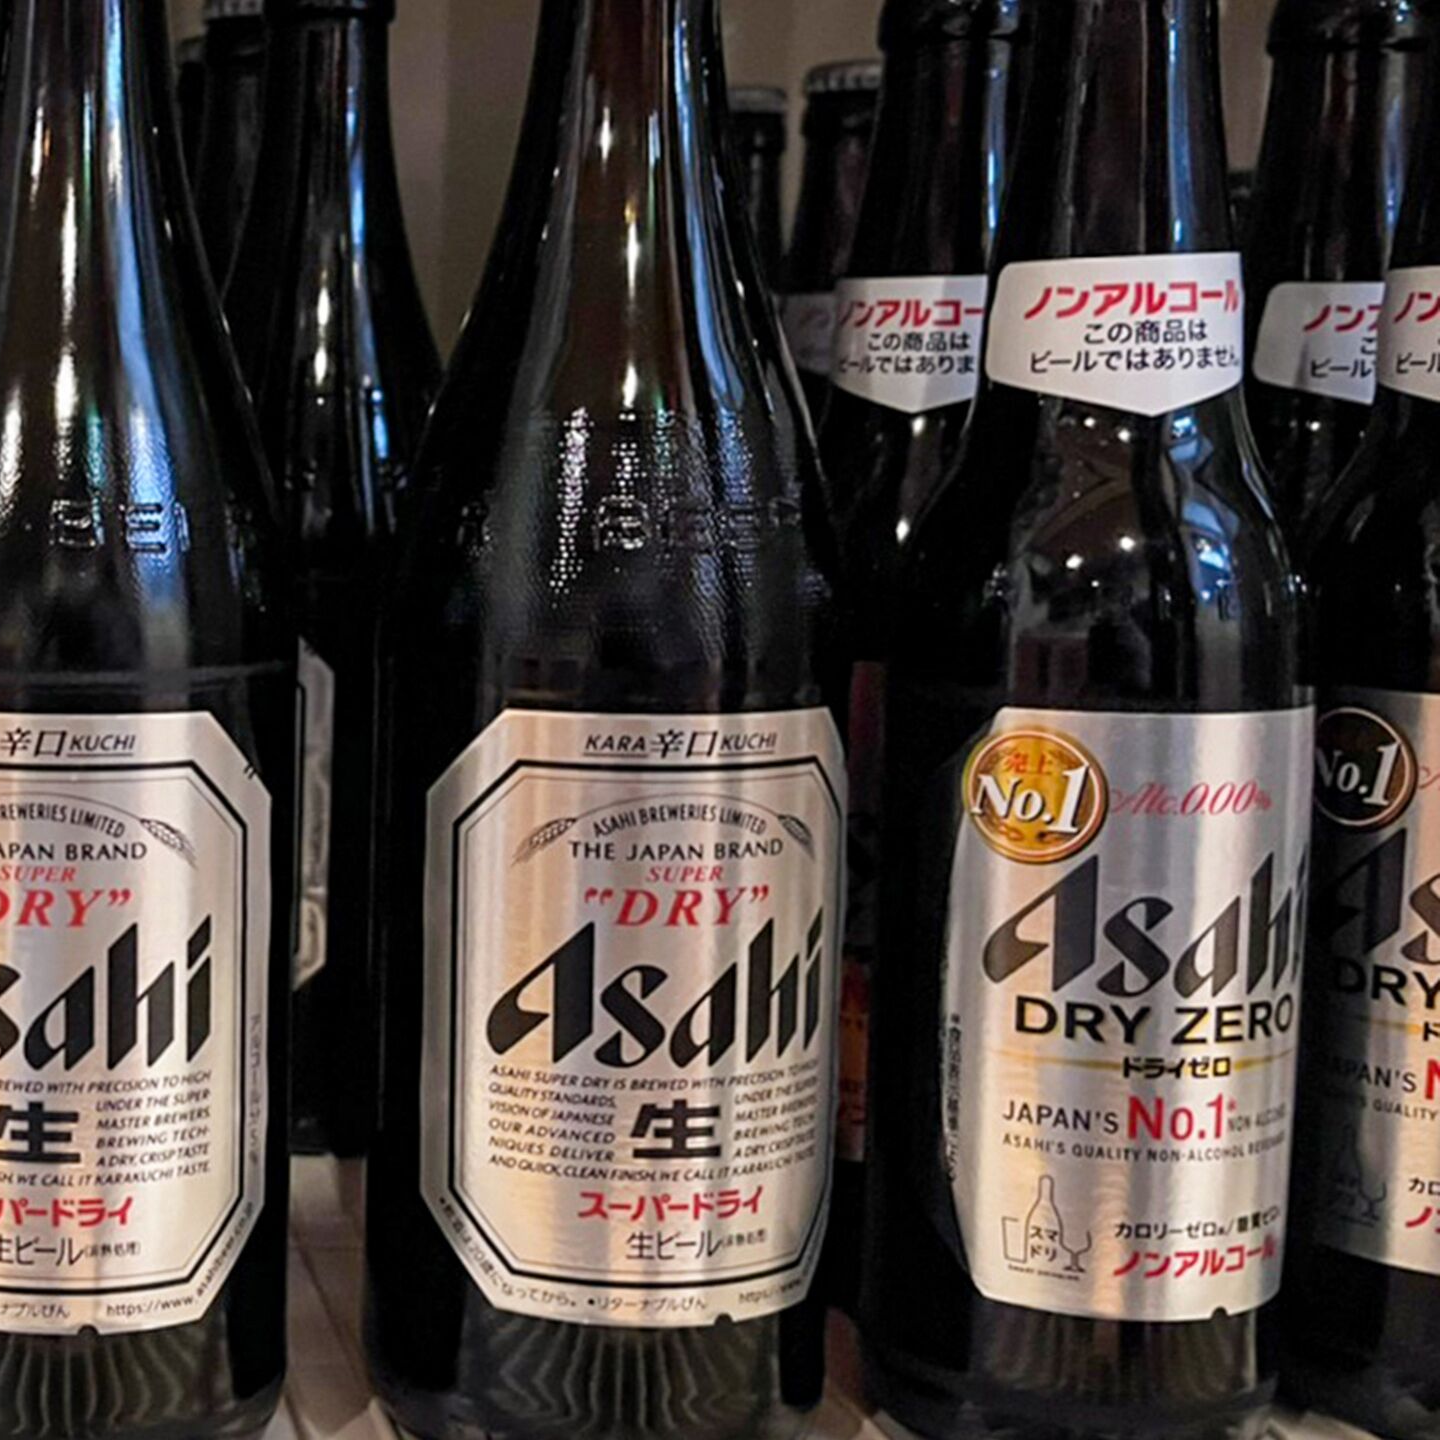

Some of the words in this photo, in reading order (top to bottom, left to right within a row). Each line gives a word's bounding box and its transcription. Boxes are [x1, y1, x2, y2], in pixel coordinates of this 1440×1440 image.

[867, 331, 971, 352] この商品は
[1083, 318, 1209, 346] この商品は
[1, 728, 67, 757] 辛口
[69, 734, 136, 753] KUCHI
[585, 734, 647, 752] KARA
[651, 729, 719, 758] 辛口
[721, 732, 778, 750] KUCHI
[971, 764, 1089, 833] No.1
[69, 808, 126, 838] LIMITED
[593, 812, 637, 837] ASAHI
[639, 804, 716, 824] BREWERIES
[719, 807, 766, 835] LIMITED
[65, 841, 147, 861] BRAND
[571, 841, 615, 860] THE
[626, 843, 704, 861] JAPAN
[715, 838, 783, 860] BRAND
[646, 865, 723, 882] SUPER
[486, 907, 823, 1069] Asahi
[1015, 995, 1152, 1044] DRY
[1171, 993, 1294, 1045] ZERO
[1122, 1057, 1232, 1079] ドライゼロ
[630, 1098, 721, 1159] 生
[1003, 1100, 1119, 1135] JAPAN'S
[1003, 1132, 1066, 1155] ASAHI'S
[1072, 1143, 1141, 1162] QUALITY
[577, 1186, 764, 1222] スーパードライ
[626, 1230, 722, 1260] 生ビール
